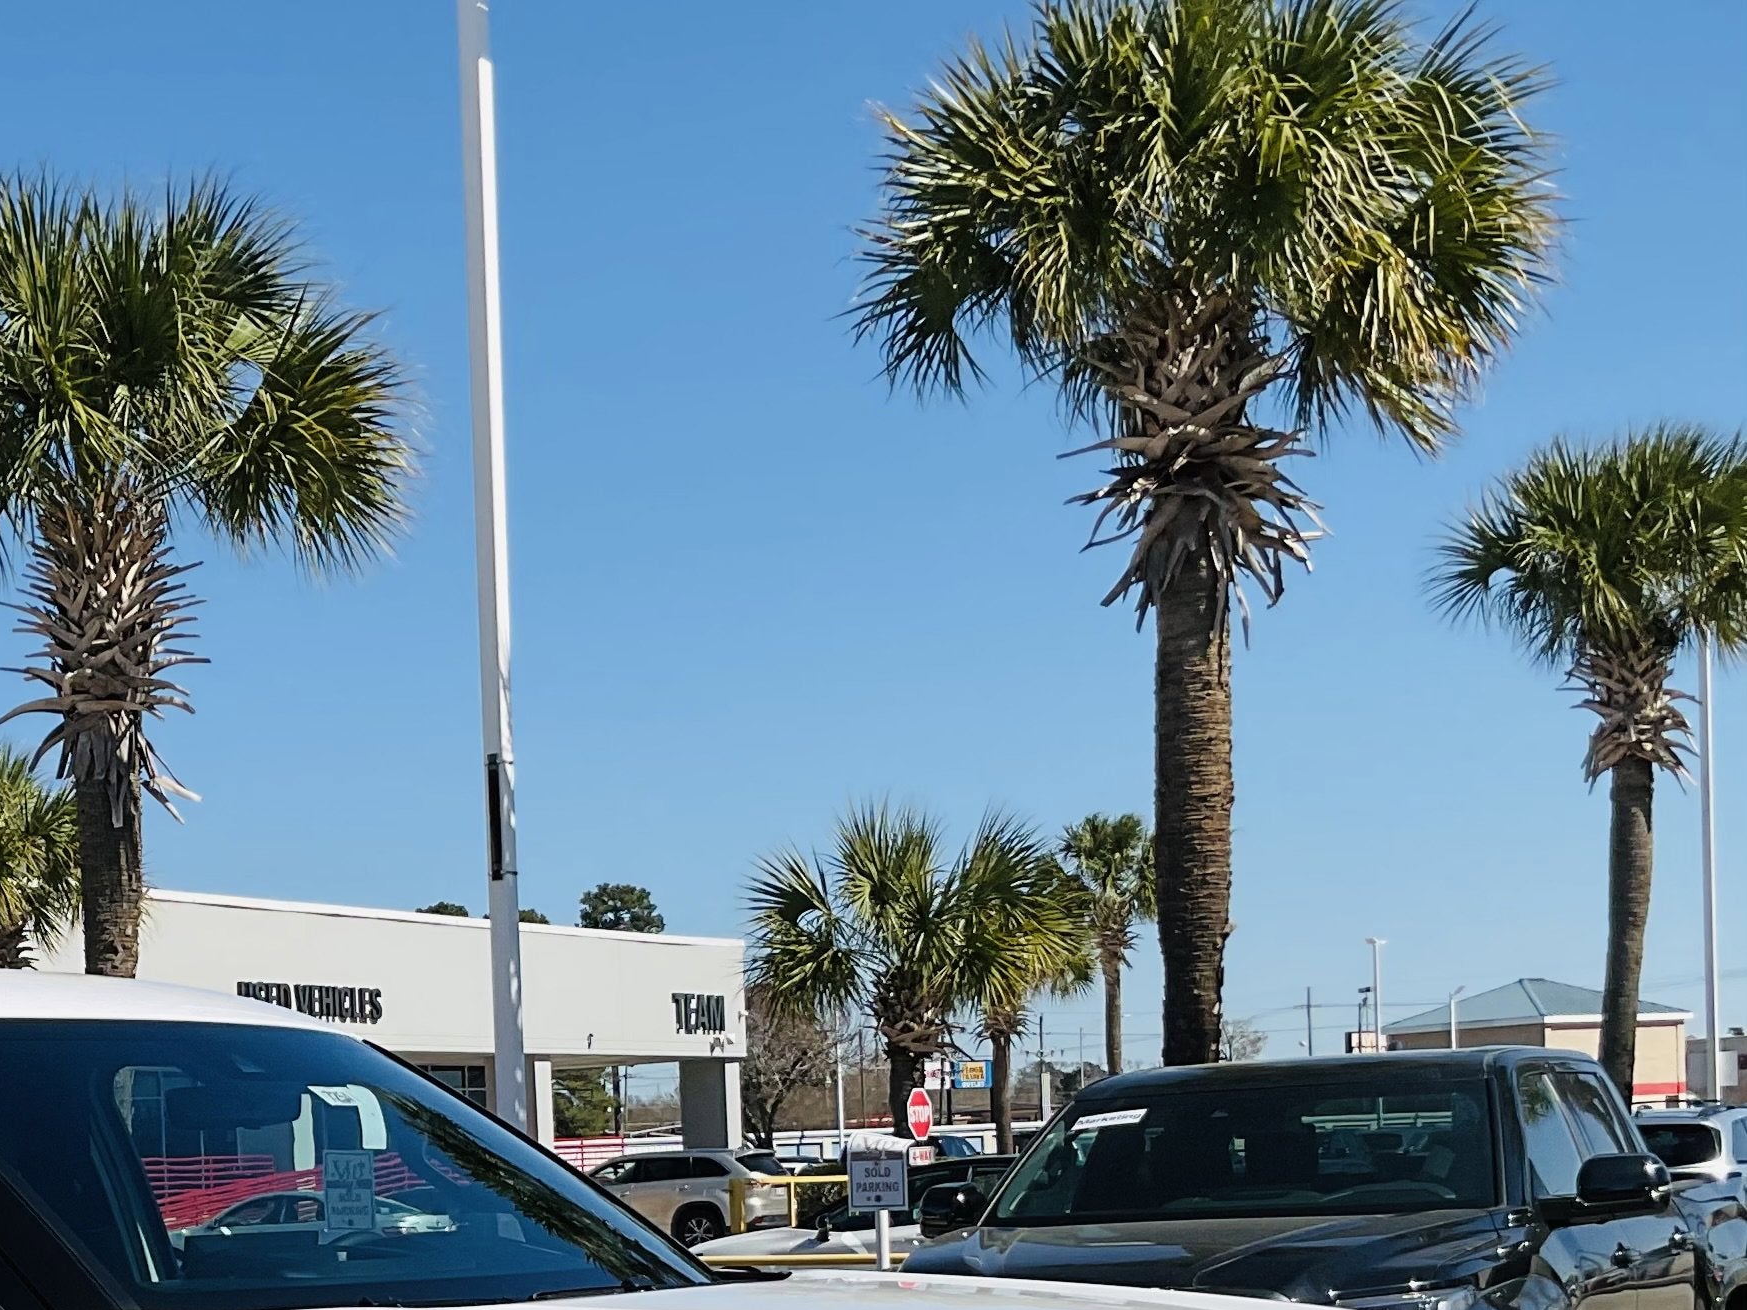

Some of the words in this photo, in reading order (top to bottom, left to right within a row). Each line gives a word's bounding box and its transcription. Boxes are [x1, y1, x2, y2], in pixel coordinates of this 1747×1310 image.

[293, 984, 383, 1024] VEHICLES
[671, 992, 725, 1035] TEAM
[909, 1105, 930, 1123] STOP
[1076, 1113, 1143, 1126] Marketing
[912, 1149, 931, 1163] 4-WAY
[864, 1166, 891, 1178] SOLD
[855, 1181, 900, 1193] PARKING
